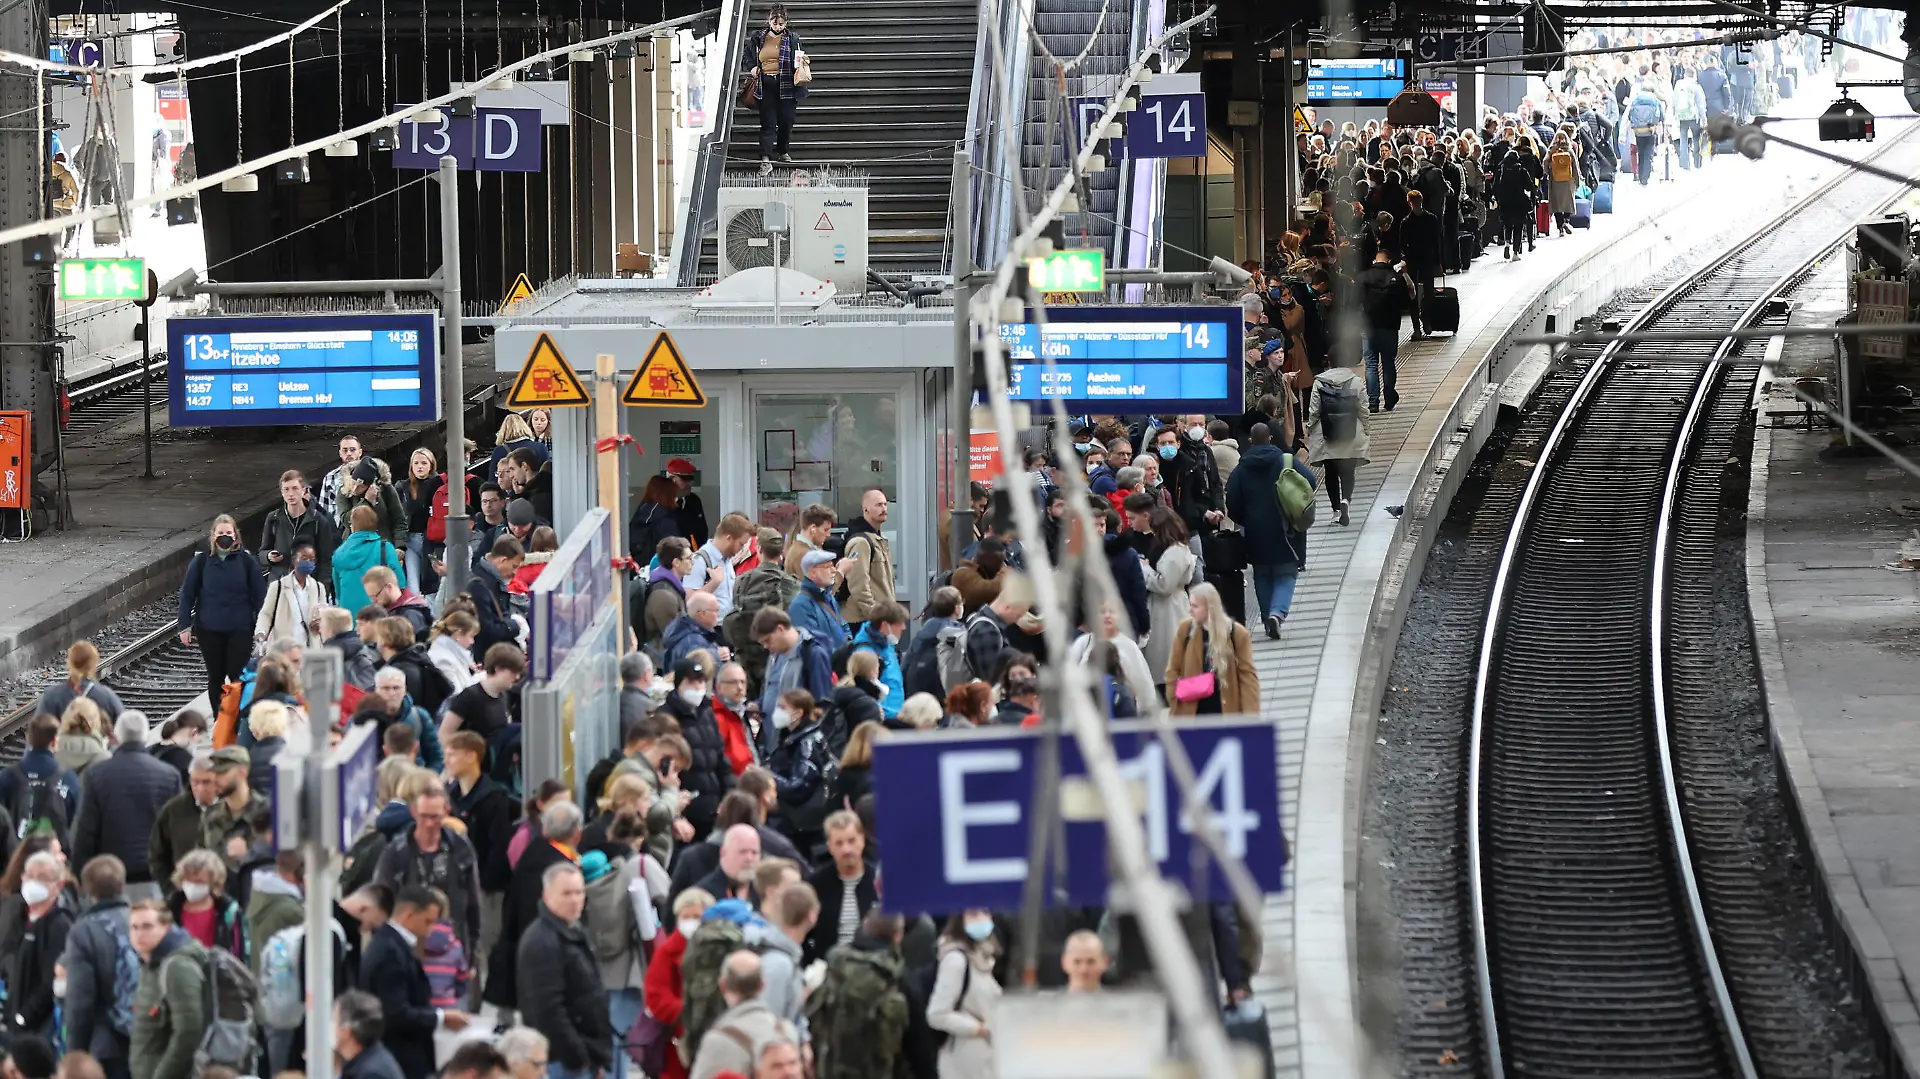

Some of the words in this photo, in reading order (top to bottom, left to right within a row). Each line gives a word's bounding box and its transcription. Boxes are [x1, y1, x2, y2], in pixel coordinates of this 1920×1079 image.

[1420, 35, 1436, 59] C
[1455, 35, 1482, 59] 14
[78, 42, 99, 68] C
[1381, 59, 1396, 73] 14
[1146, 100, 1195, 142] 14
[403, 112, 450, 155] 13
[485, 114, 519, 159] D
[388, 331, 418, 342] 14:06
[998, 324, 1026, 336] 13:46
[1181, 323, 1210, 349] 14
[185, 335, 213, 361] 13
[1041, 342, 1071, 356] Köln
[231, 352, 280, 366] Itzehoe
[1041, 373, 1055, 382] ICE
[1087, 373, 1121, 382] Aachen
[186, 383, 212, 393] 13:57
[232, 383, 249, 392] RE3
[278, 381, 310, 392] Uelzen
[1087, 385, 1127, 395] München
[1129, 385, 1146, 395] Hbf
[186, 396, 212, 406] 14:37
[232, 395, 255, 405] RB41
[278, 394, 314, 405] Bremen
[315, 393, 333, 403] Hbf
[939, 749, 1027, 885] E
[1119, 736, 1260, 863] 14
